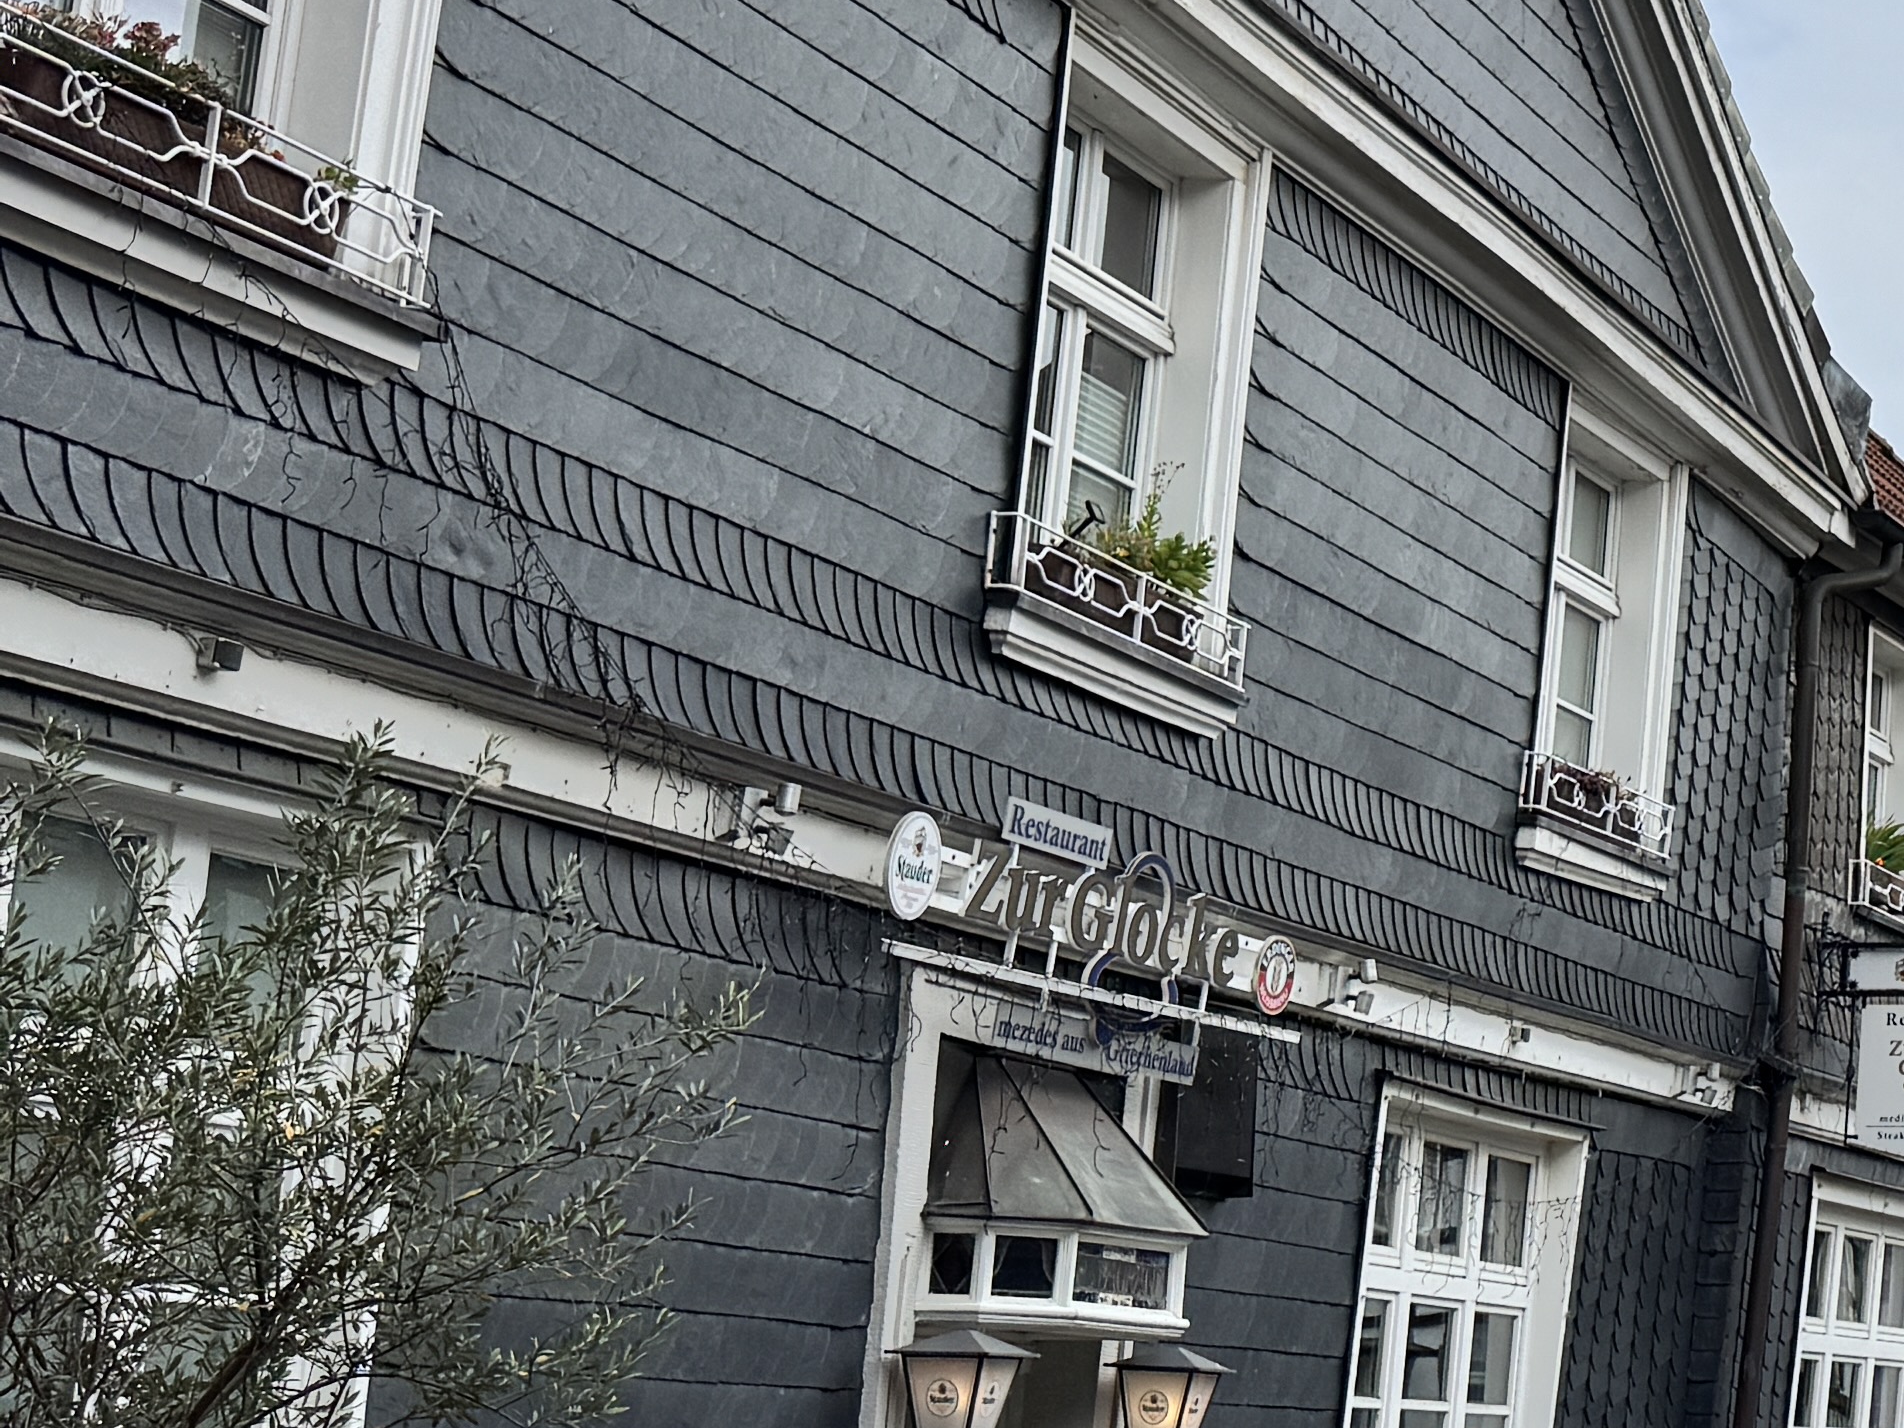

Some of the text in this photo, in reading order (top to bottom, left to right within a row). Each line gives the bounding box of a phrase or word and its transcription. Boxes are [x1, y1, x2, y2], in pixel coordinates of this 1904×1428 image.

[1007, 803, 1107, 862] Restaurant
[962, 851, 1239, 986] Zur Glocke
[997, 1020, 1195, 1077] mezedes aus Griechenland
[1877, 1132, 1904, 1141] Steak
